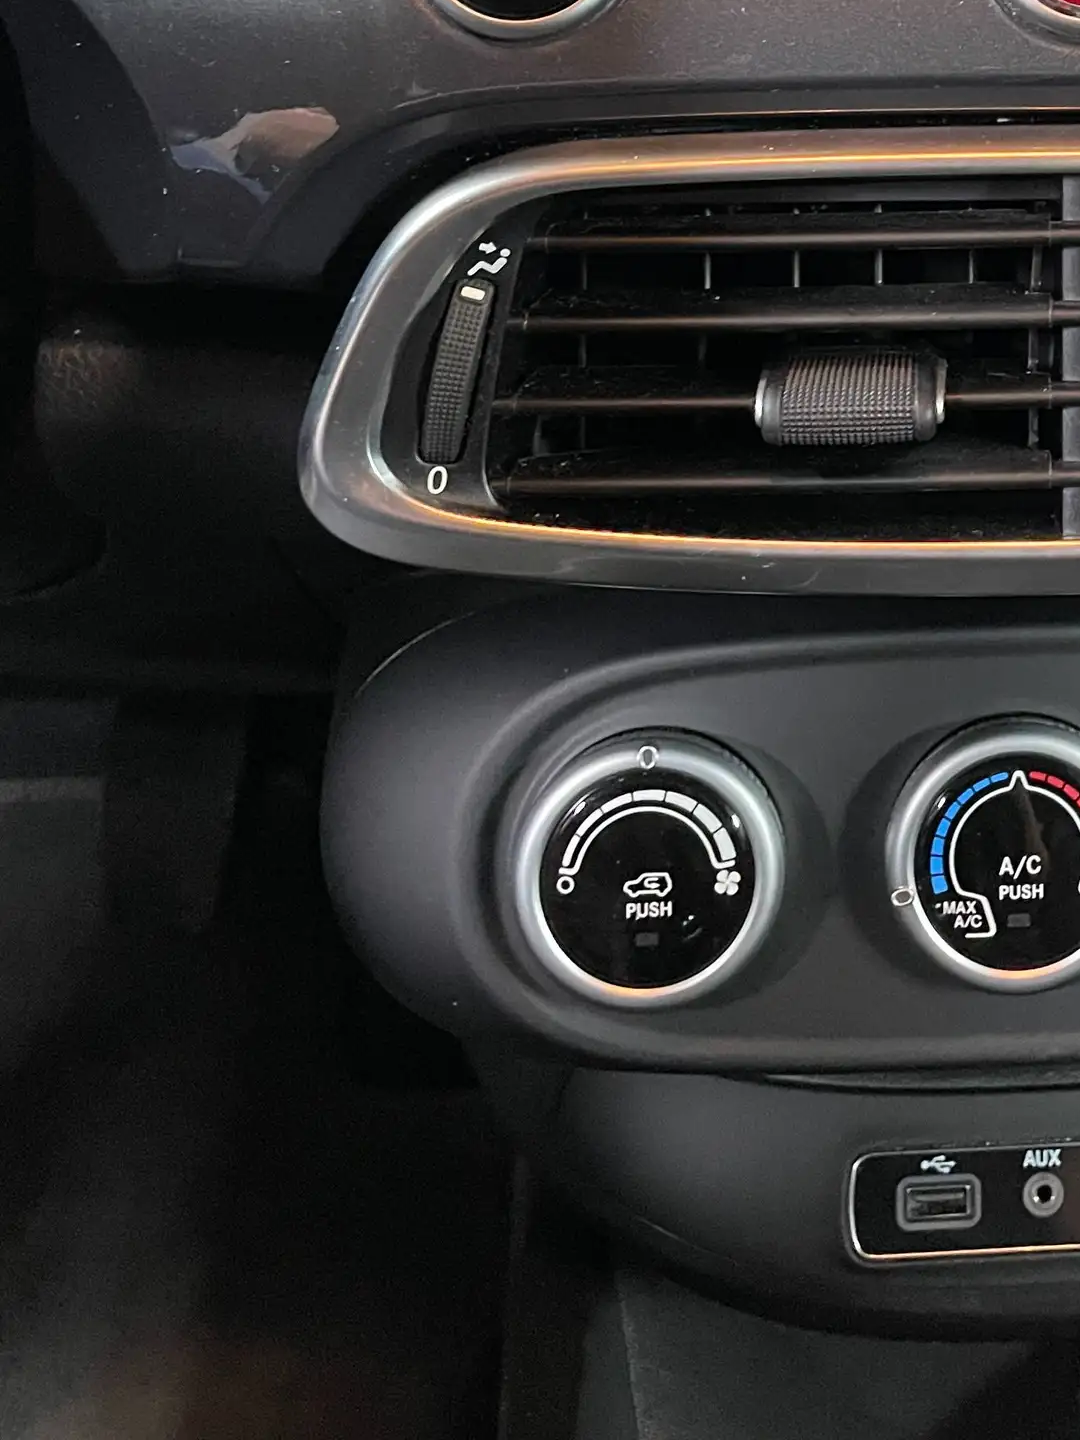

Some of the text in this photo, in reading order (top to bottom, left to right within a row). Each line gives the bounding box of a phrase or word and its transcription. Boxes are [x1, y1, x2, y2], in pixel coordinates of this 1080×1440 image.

[998, 855, 1042, 880] A/C
[999, 883, 1045, 901] PUSH
[625, 900, 673, 921] PUSH
[943, 900, 977, 915] MAX
[953, 914, 983, 929] A/C
[1022, 1148, 1062, 1169] AUX
